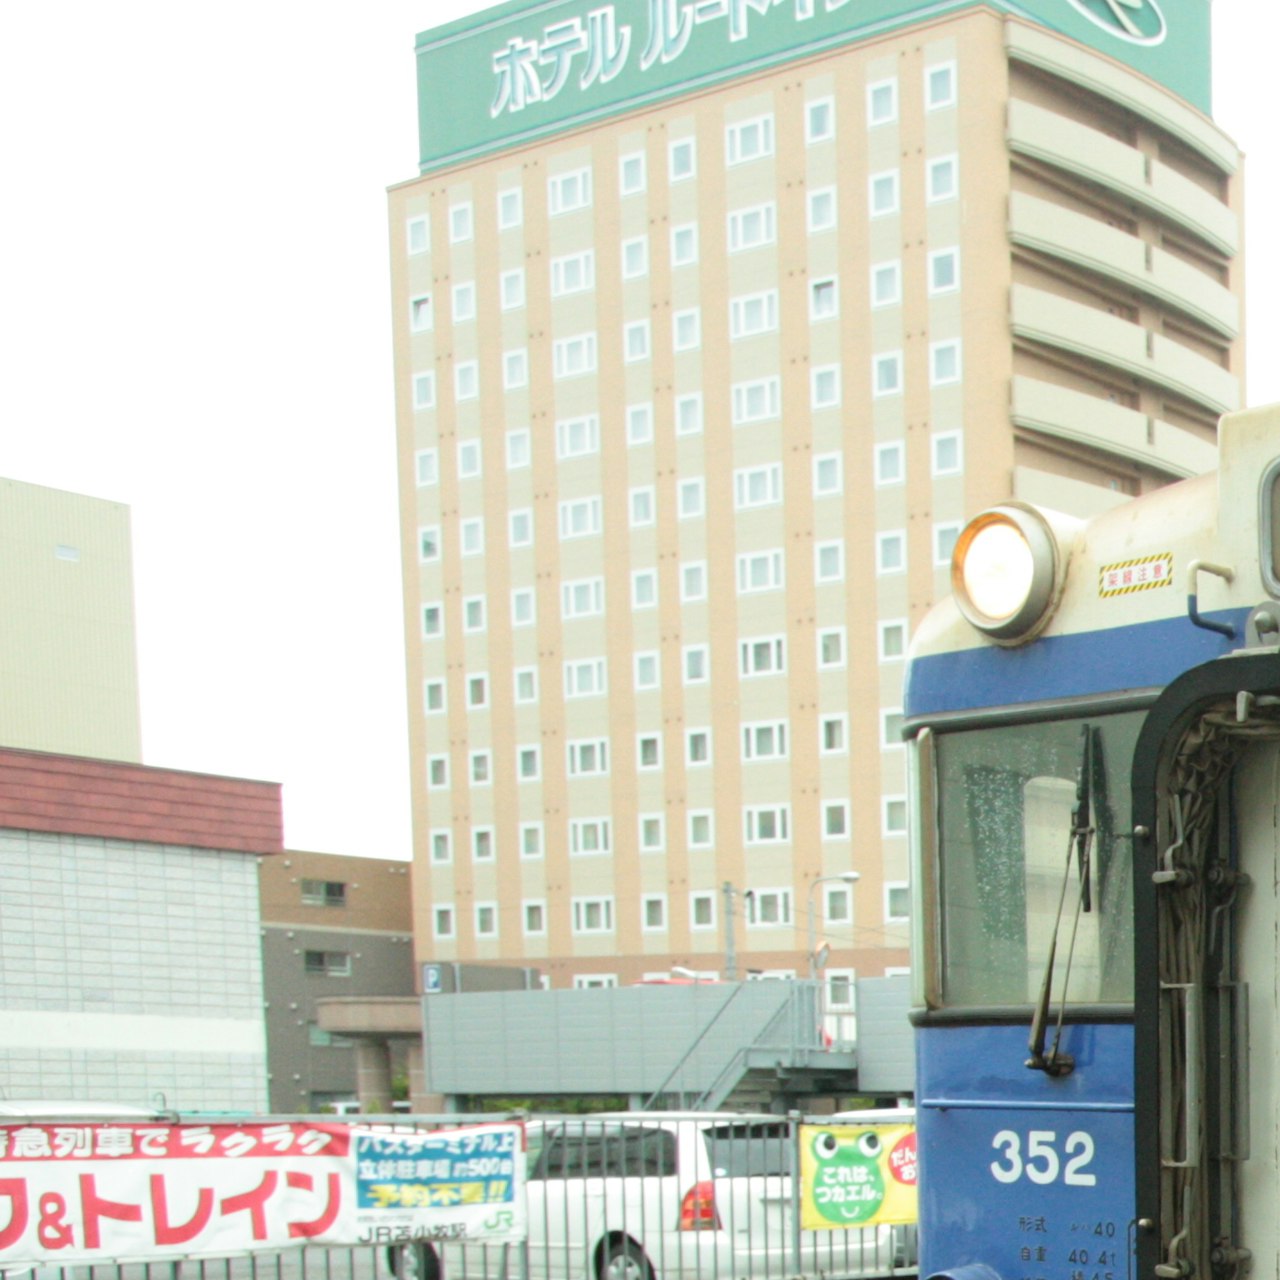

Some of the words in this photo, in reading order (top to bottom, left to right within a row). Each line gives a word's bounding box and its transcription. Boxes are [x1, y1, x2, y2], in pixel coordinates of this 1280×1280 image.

[490, 5, 631, 119] ホテル
[180, 1124, 333, 1158] ラクラク
[990, 1129, 1097, 1187] 352
[483, 1210, 514, 1230] JR
[1018, 1216, 1048, 1233] 形式
[1020, 1246, 1048, 1263] 自重
